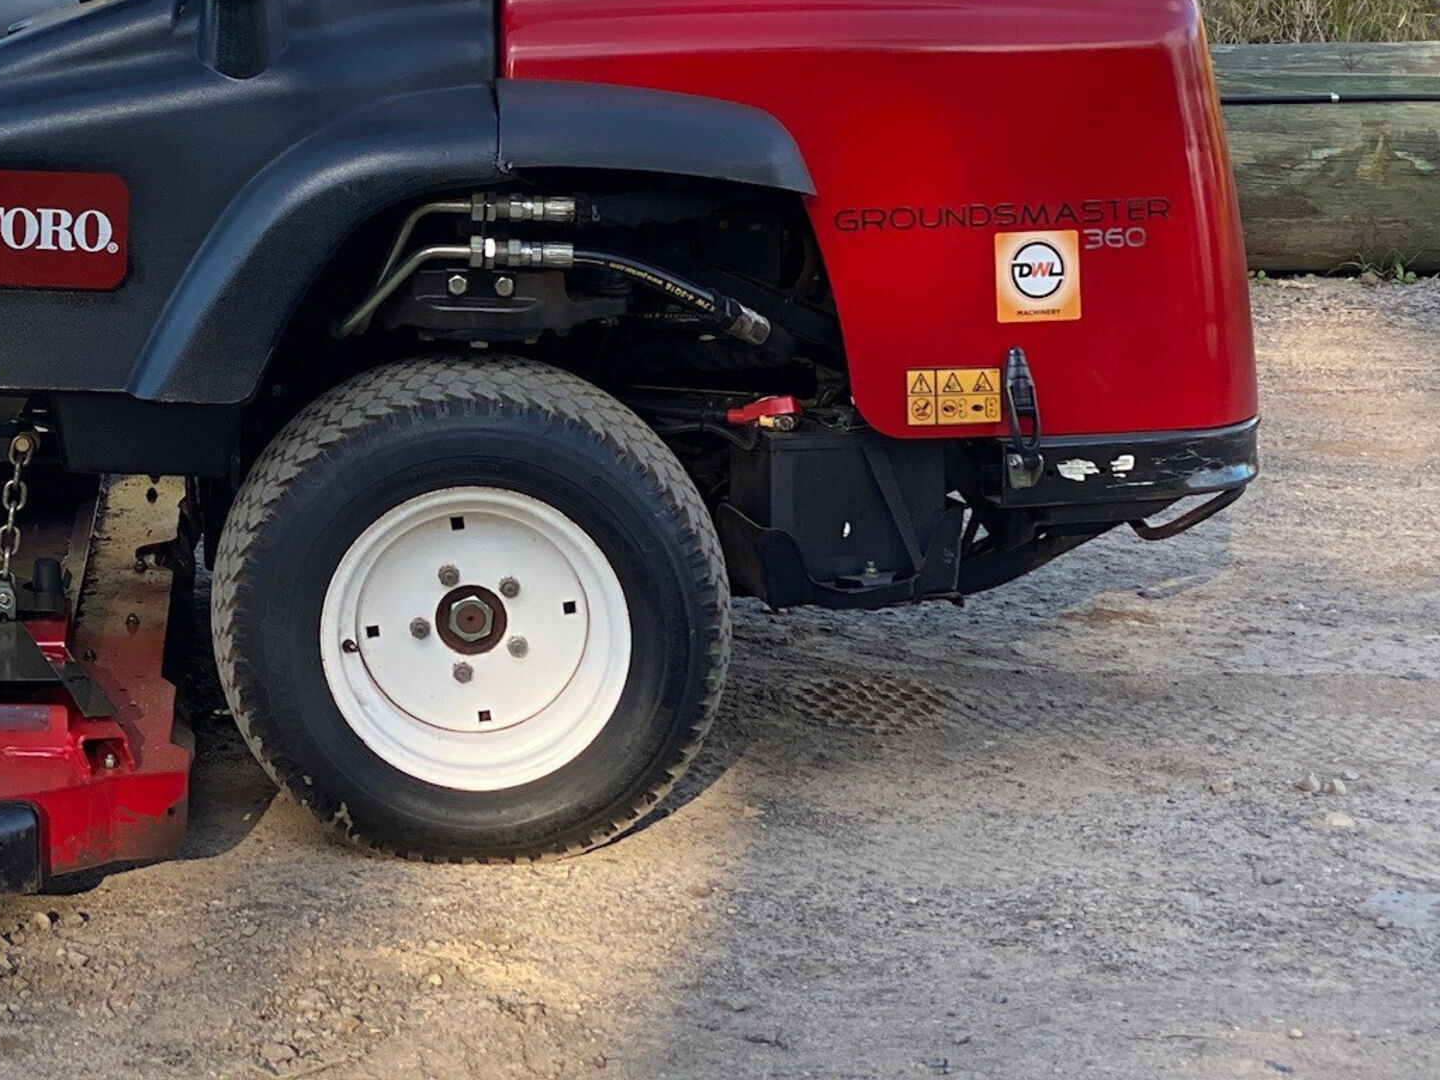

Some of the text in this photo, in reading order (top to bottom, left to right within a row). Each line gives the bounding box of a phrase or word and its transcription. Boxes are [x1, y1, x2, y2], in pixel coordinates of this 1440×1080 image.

[833, 197, 1172, 232] GROUNDSMASTER
[1082, 226, 1148, 250] 360
[1013, 262, 1063, 278] DWL
[1016, 308, 1062, 317] MACHINERY
